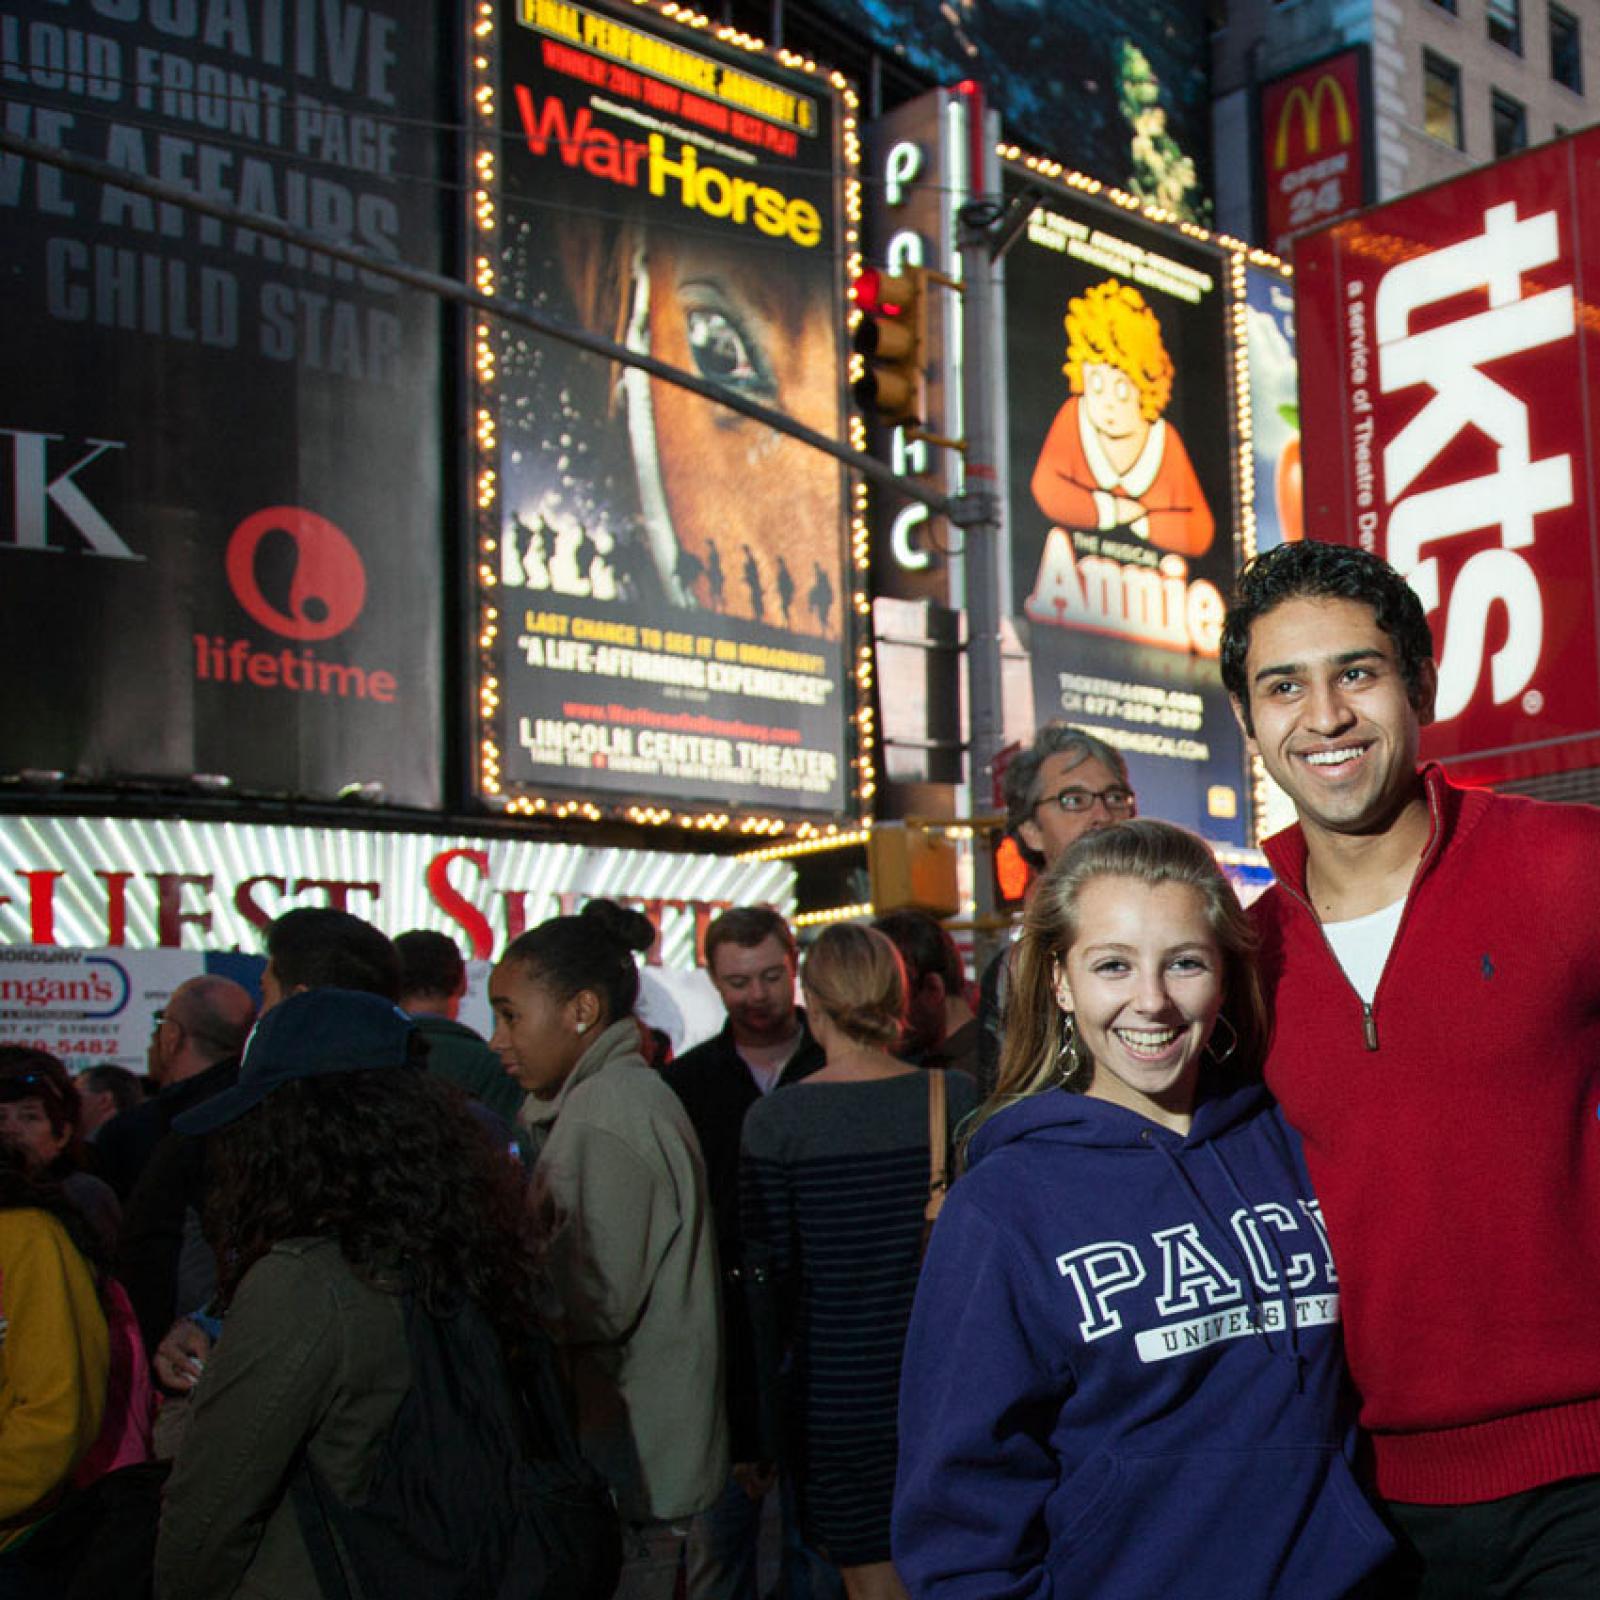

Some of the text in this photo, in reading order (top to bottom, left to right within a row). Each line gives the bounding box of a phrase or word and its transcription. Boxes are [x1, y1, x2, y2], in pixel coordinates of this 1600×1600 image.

[136, 46, 286, 146] FRONT
[295, 94, 397, 182] PAGE
[101, 122, 400, 297] AFFAIRS
[1280, 152, 1348, 193] OPEN
[1289, 177, 1342, 226] 24
[46, 237, 400, 385] CHILD STAR
[1348, 301, 1369, 384] service
[1355, 416, 1376, 507] Theatre
[1375, 200, 1578, 722] tkts
[524, 608, 569, 637] LAST
[571, 616, 638, 648] CHANCE
[640, 626, 663, 651] TO
[1025, 525, 1228, 659] Annie
[193, 633, 398, 703] lifetime
[519, 715, 633, 757] LINCOLN
[637, 729, 733, 770] CENTER
[735, 741, 837, 782] THEATER
[1056, 1199, 1339, 1343] PAC
[1161, 1300, 1329, 1352] UNIVESTY
